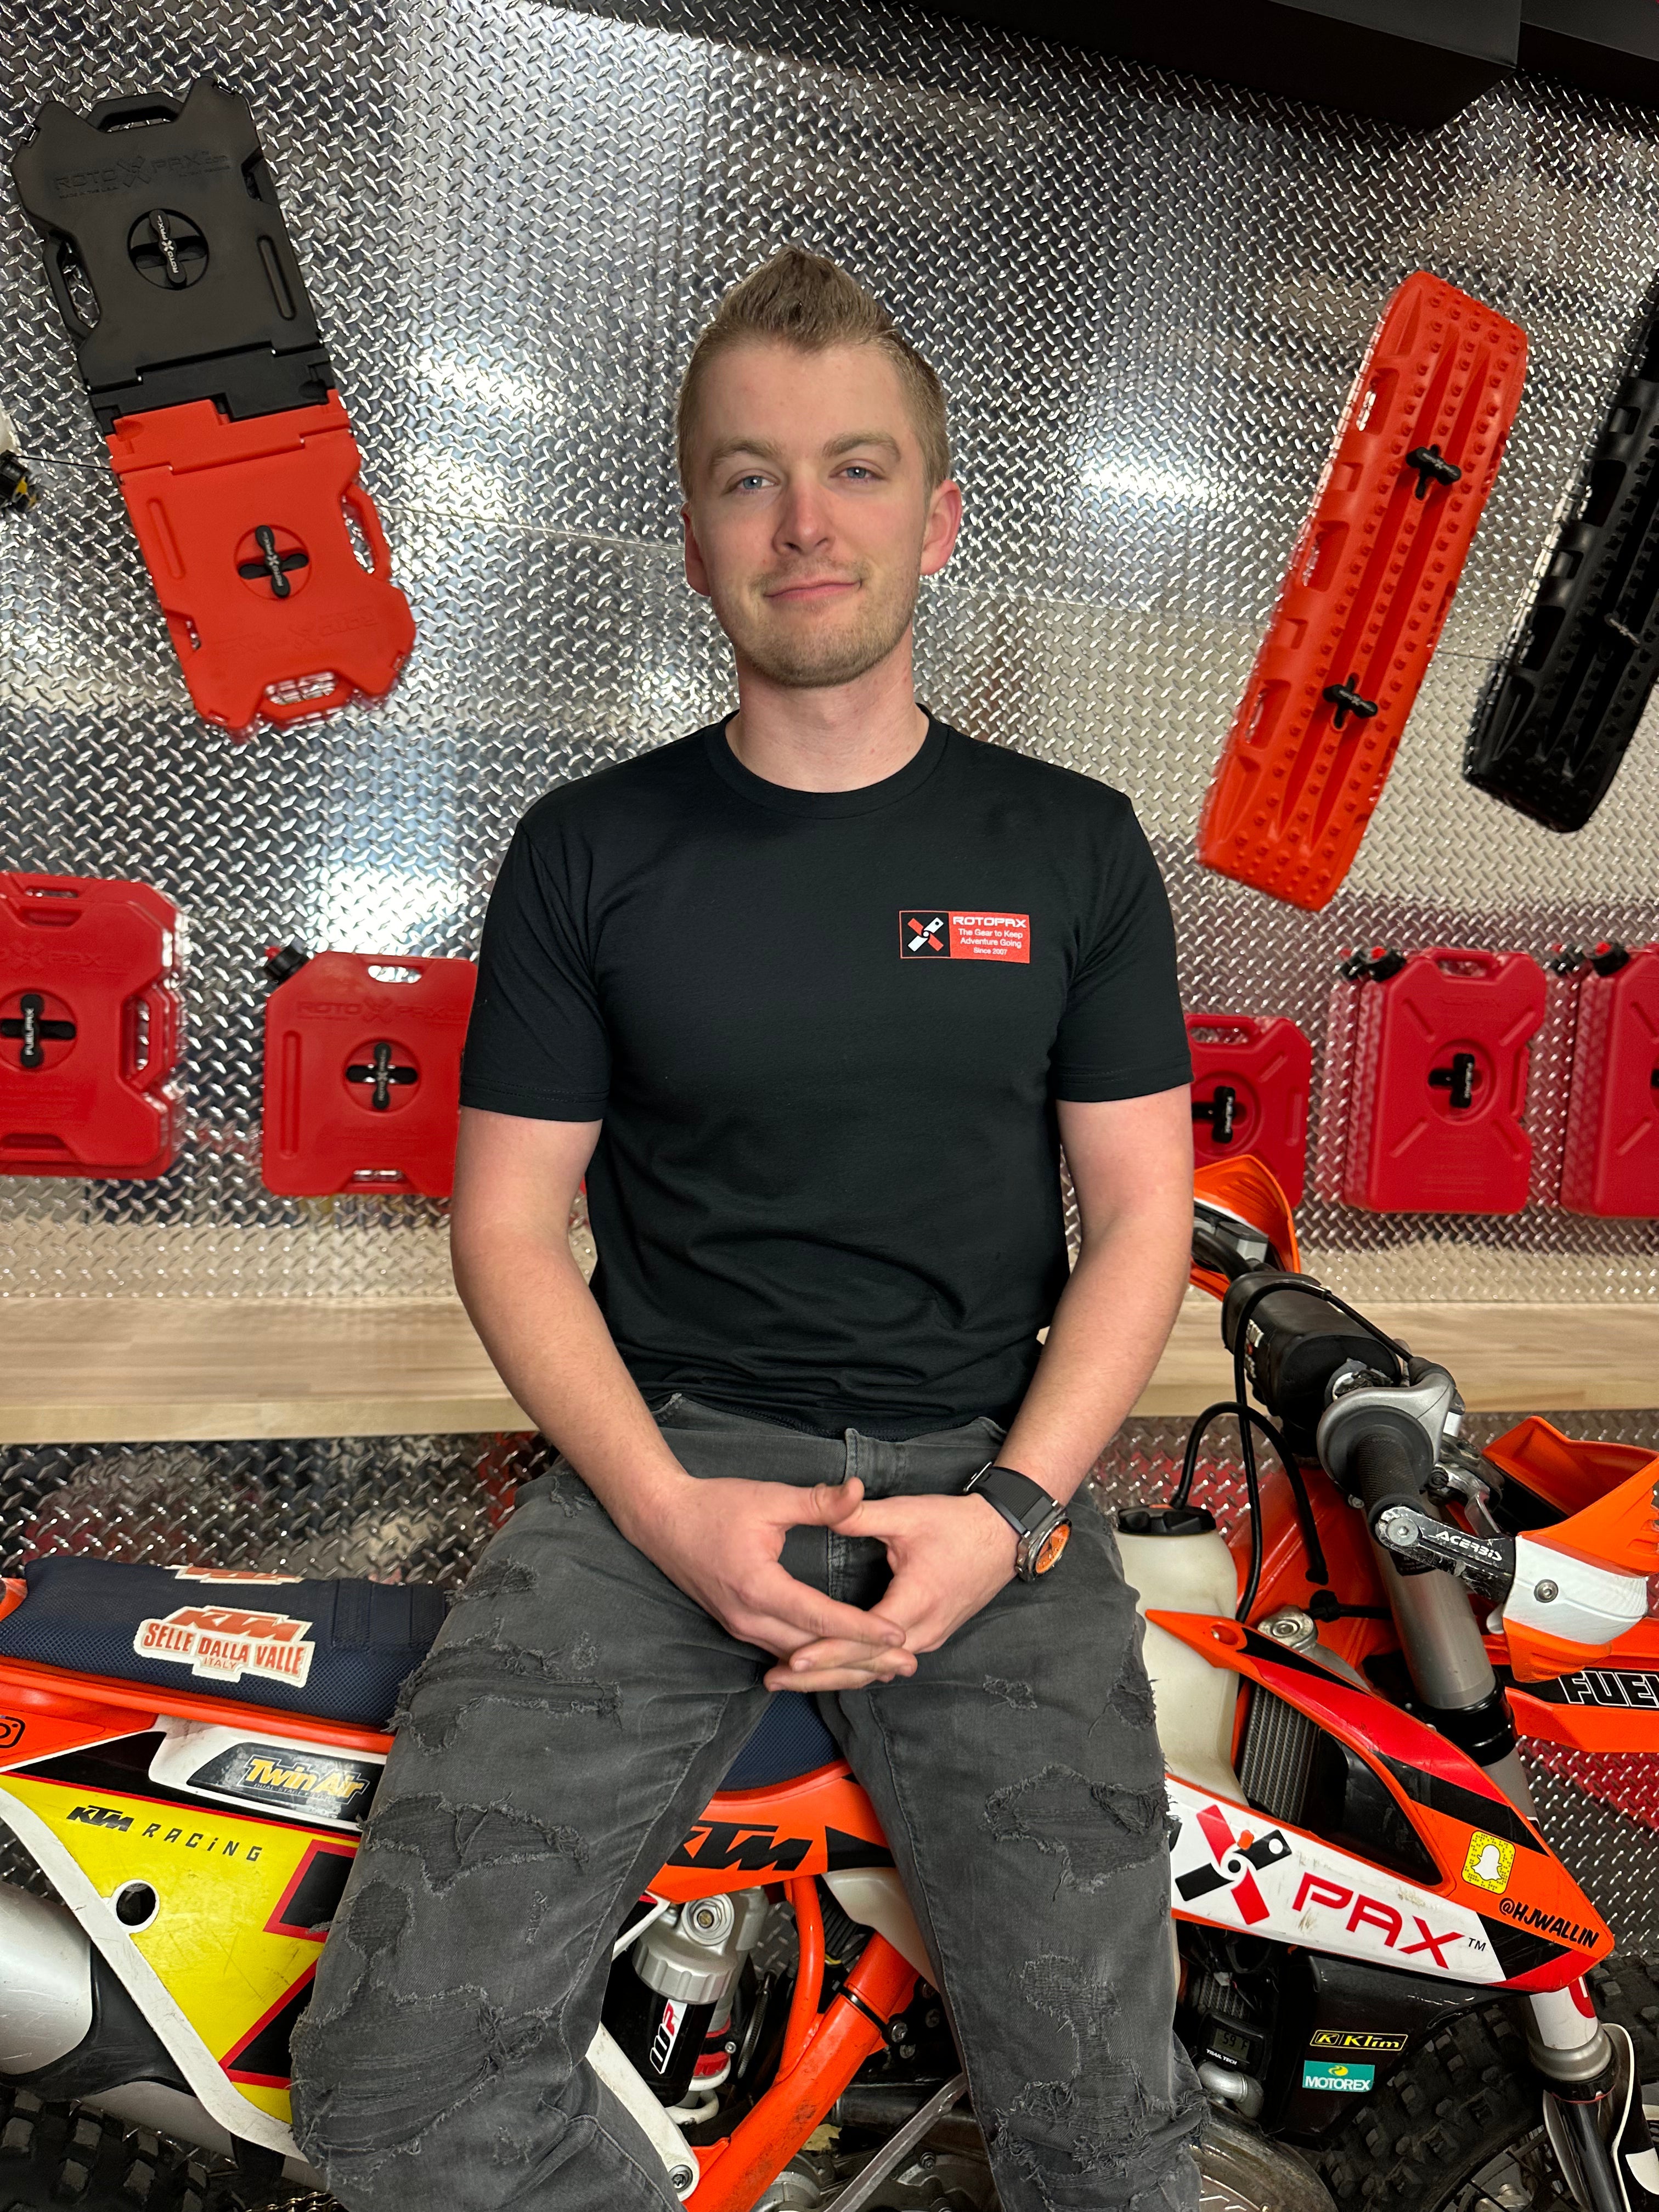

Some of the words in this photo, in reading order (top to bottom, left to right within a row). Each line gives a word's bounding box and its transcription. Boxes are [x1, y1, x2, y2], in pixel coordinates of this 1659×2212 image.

[55, 168, 117, 190] ROTO
[158, 223, 168, 240] PAX
[167, 251, 179, 273] ROTO
[953, 916, 1027, 928] ROTOPAX
[960, 937, 998, 946] Adventure
[1000, 939, 1022, 949] Going
[1004, 930, 1023, 939] Keep
[25, 1007, 34, 1056] FUELPAX
[168, 1609, 300, 1642] KTM
[143, 1622, 195, 1652] SELLE
[198, 1637, 250, 1664] DALLA
[255, 1645, 304, 1675] VALLE
[204, 1657, 238, 1669] ITALY
[245, 1758, 317, 1791] Twin
[311, 1772, 365, 1798] Air
[66, 1805, 134, 1832] KTM
[666, 1819, 814, 1871] KTM
[1292, 1872, 1465, 1970] PAX
[1499, 1897, 1600, 1949] @HJWALLIN
[1222, 2032, 1237, 2047] 59
[1206, 2048, 1223, 2060] TRAIL
[1222, 2056, 1238, 2066] TECH
[1305, 2075, 1371, 2091] MOTOREX
